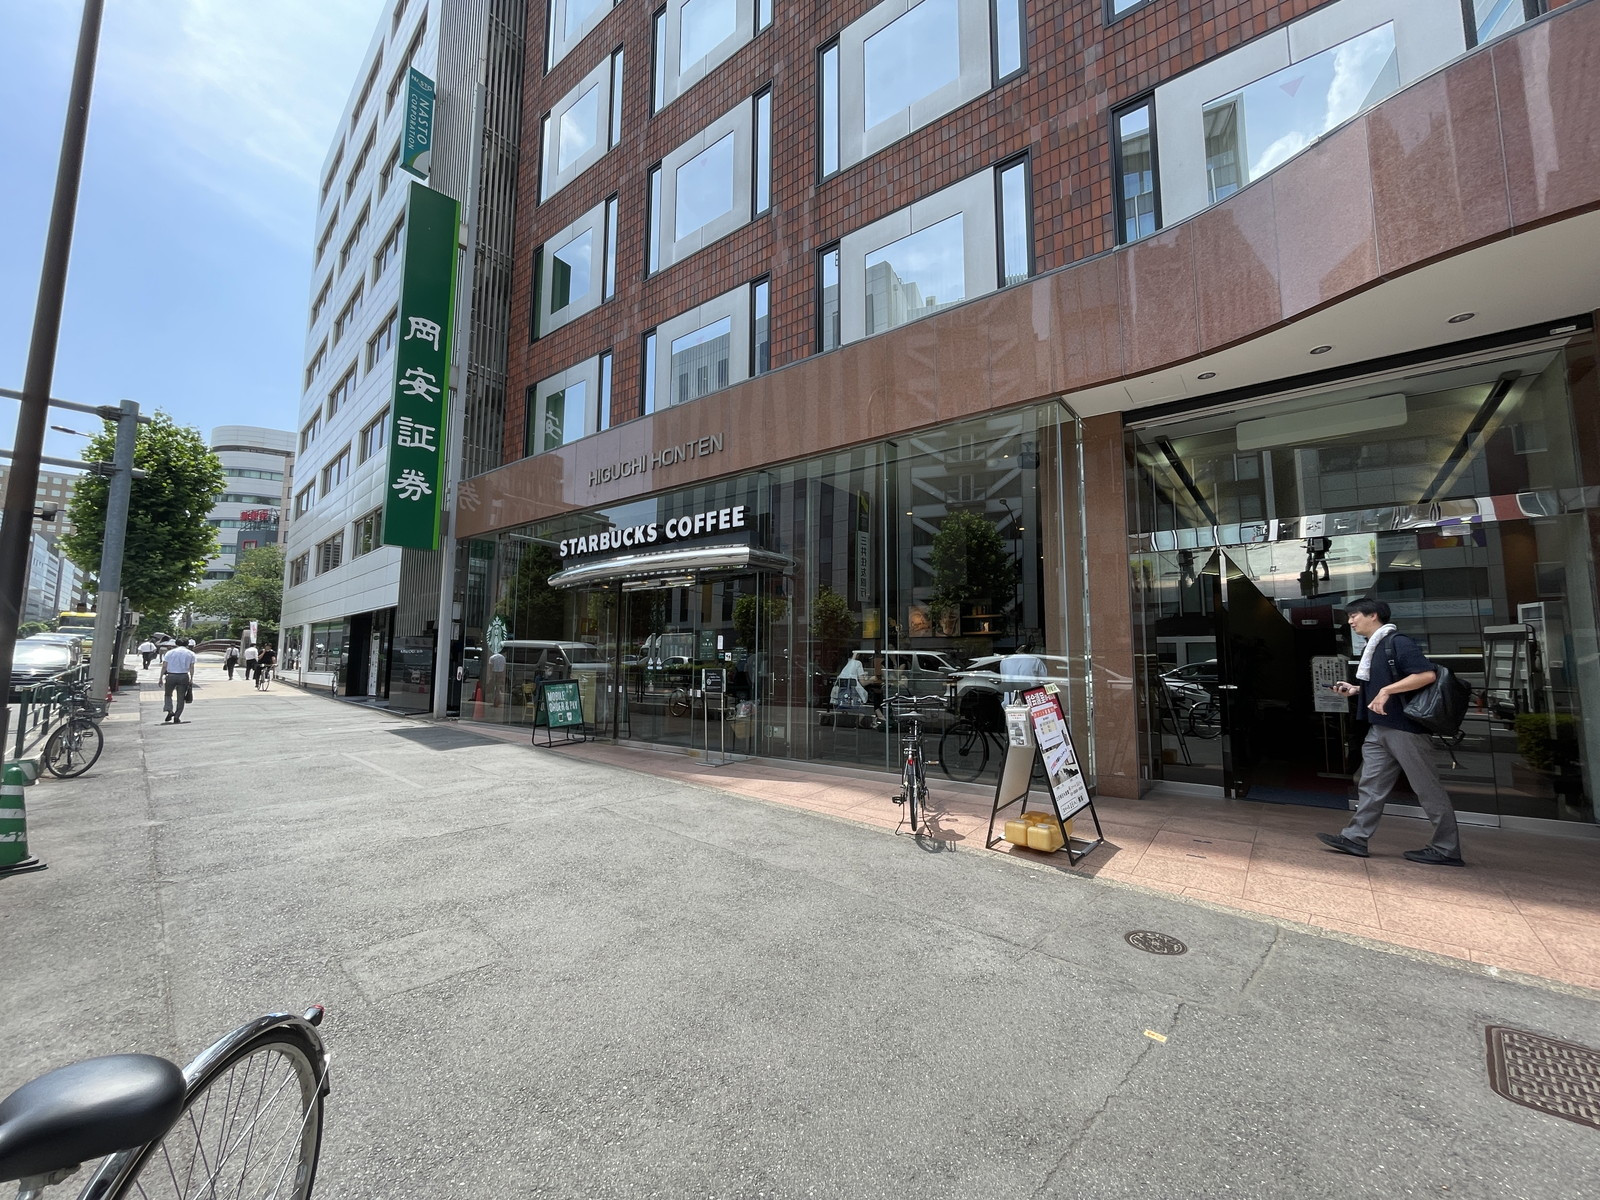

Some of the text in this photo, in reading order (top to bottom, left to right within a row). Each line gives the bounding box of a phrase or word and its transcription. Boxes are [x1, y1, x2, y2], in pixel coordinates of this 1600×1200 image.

[408, 94, 418, 149] CORPORATION
[417, 98, 430, 145] NASTO
[392, 316, 442, 502] 岡安証券
[588, 432, 724, 488] HIGUCHI HONTEN
[559, 505, 746, 558] STARBUCKS COFFEE
[547, 691, 565, 702] MOBILE
[548, 702, 565, 712] ORDER
[569, 701, 578, 709] PAY
